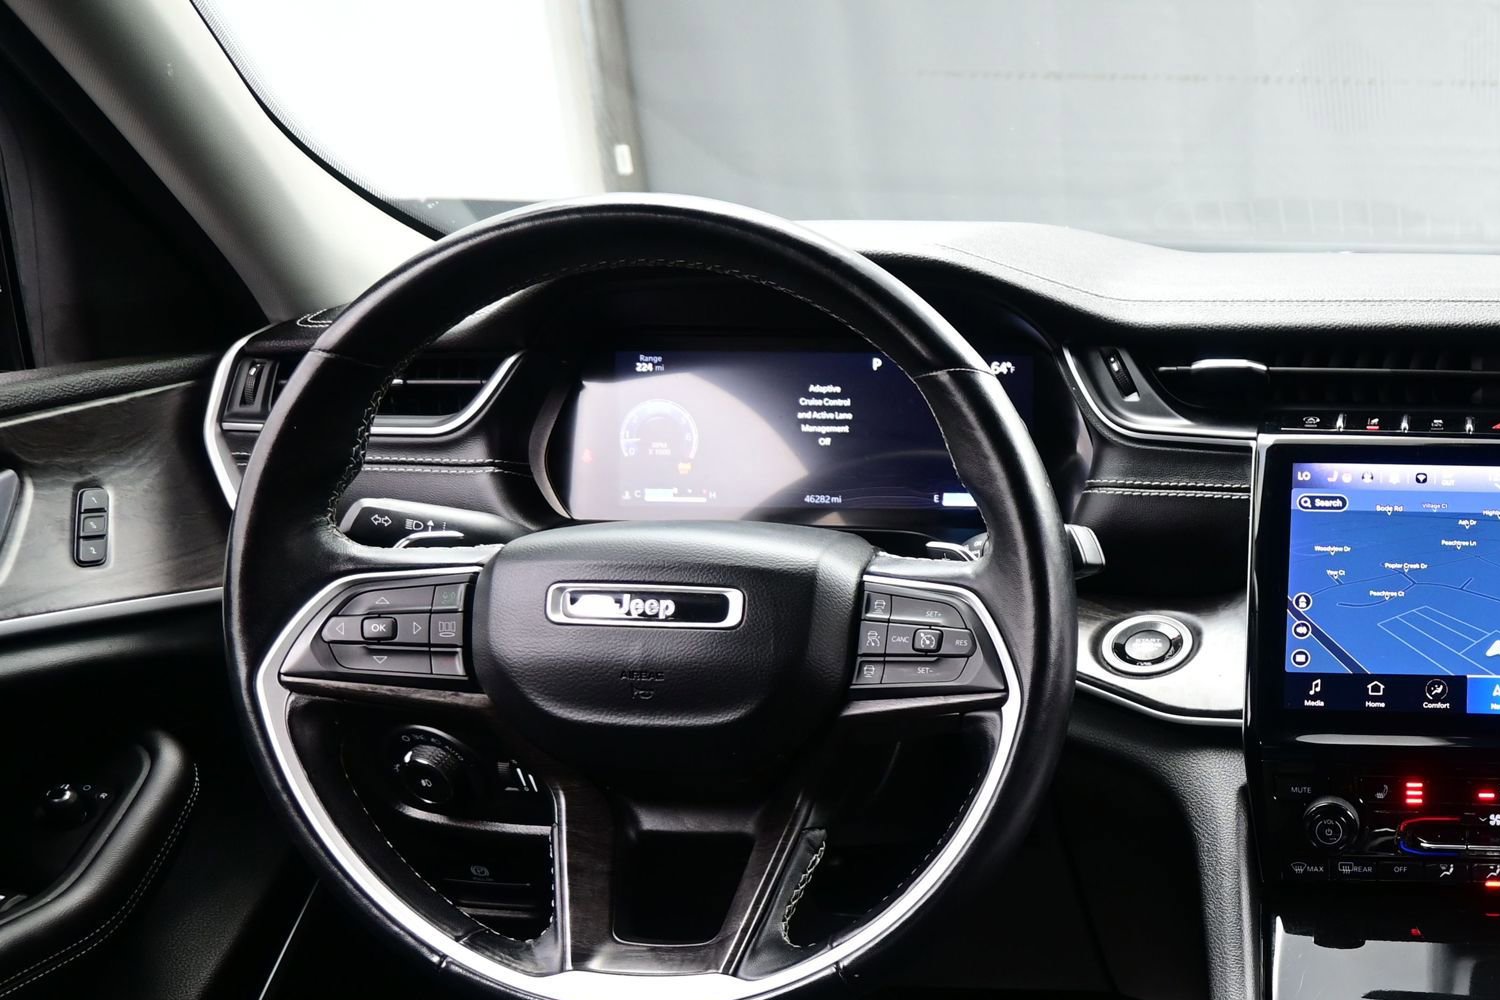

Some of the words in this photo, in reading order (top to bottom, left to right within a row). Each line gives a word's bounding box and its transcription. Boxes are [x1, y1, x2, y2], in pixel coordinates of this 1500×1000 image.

[639, 354, 663, 363] Range
[635, 362, 654, 372] 224
[655, 364, 665, 372] mi
[872, 357, 882, 371] P
[808, 384, 842, 394] Adaptive
[799, 397, 823, 406] Cruise
[823, 398, 851, 407] Control
[797, 411, 812, 419] and
[812, 411, 835, 420] Active
[835, 411, 853, 420] Lane
[800, 424, 850, 434] Management
[818, 437, 832, 446] Off
[1297, 471, 1311, 481] LO
[804, 495, 830, 503] 46282
[830, 495, 842, 503] mi
[933, 494, 940, 503] E
[1314, 497, 1343, 508] Search
[1394, 505, 1404, 513] Rd
[1422, 502, 1441, 511] Village
[1441, 539, 1469, 547] Peachtree
[1343, 545, 1351, 553] Dr
[1384, 562, 1403, 571] Poplar
[1420, 563, 1428, 571] Dr
[614, 593, 676, 620] Jeep
[925, 609, 942, 618] SET+
[371, 623, 387, 633] OK
[890, 635, 910, 644] CANC
[954, 639, 970, 648] RES
[917, 666, 934, 675] SET-
[619, 670, 665, 682] AIRBAG
[1304, 699, 1325, 707] Media
[1365, 700, 1386, 708] Home
[1422, 701, 1450, 709] Comfort
[1290, 786, 1312, 794] MUTE
[1306, 865, 1325, 873] MAX
[1393, 865, 1408, 873] OFF
